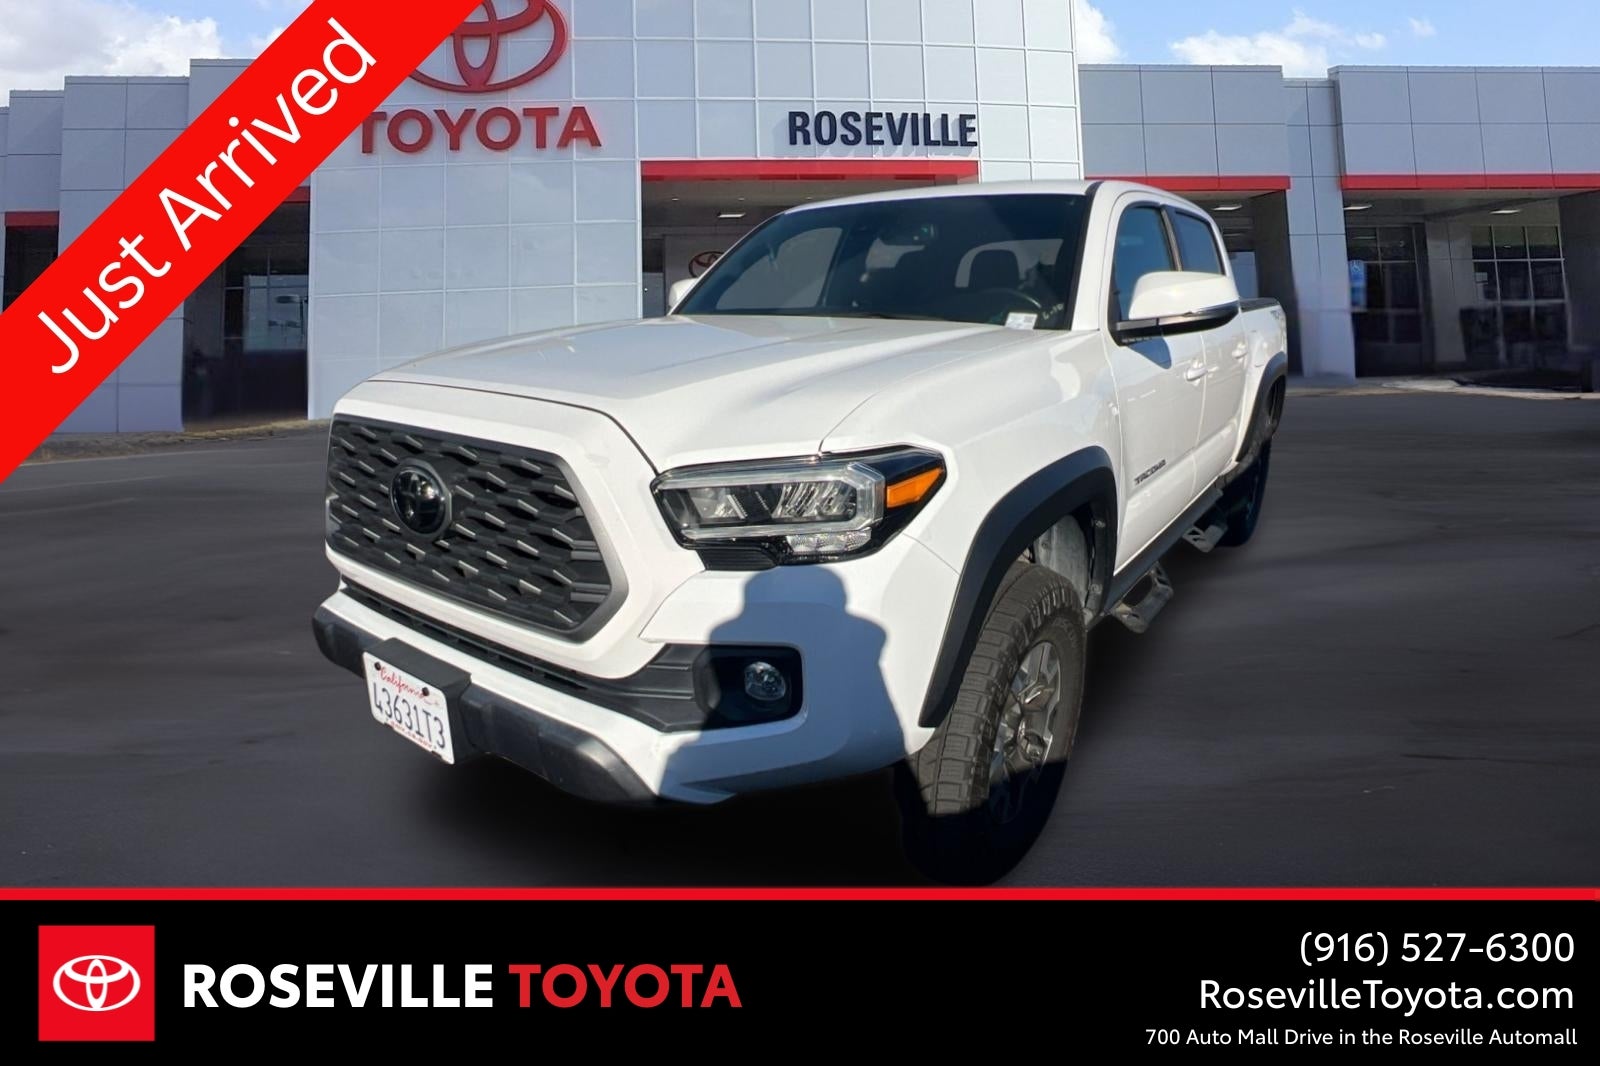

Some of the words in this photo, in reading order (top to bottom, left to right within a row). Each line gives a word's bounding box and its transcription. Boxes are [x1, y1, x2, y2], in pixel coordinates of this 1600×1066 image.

[361, 106, 602, 154] TOYOTA
[788, 110, 978, 147] ROSEVILLE
[1133, 458, 1167, 486] TACOMA
[372, 681, 447, 750] 43631T3
